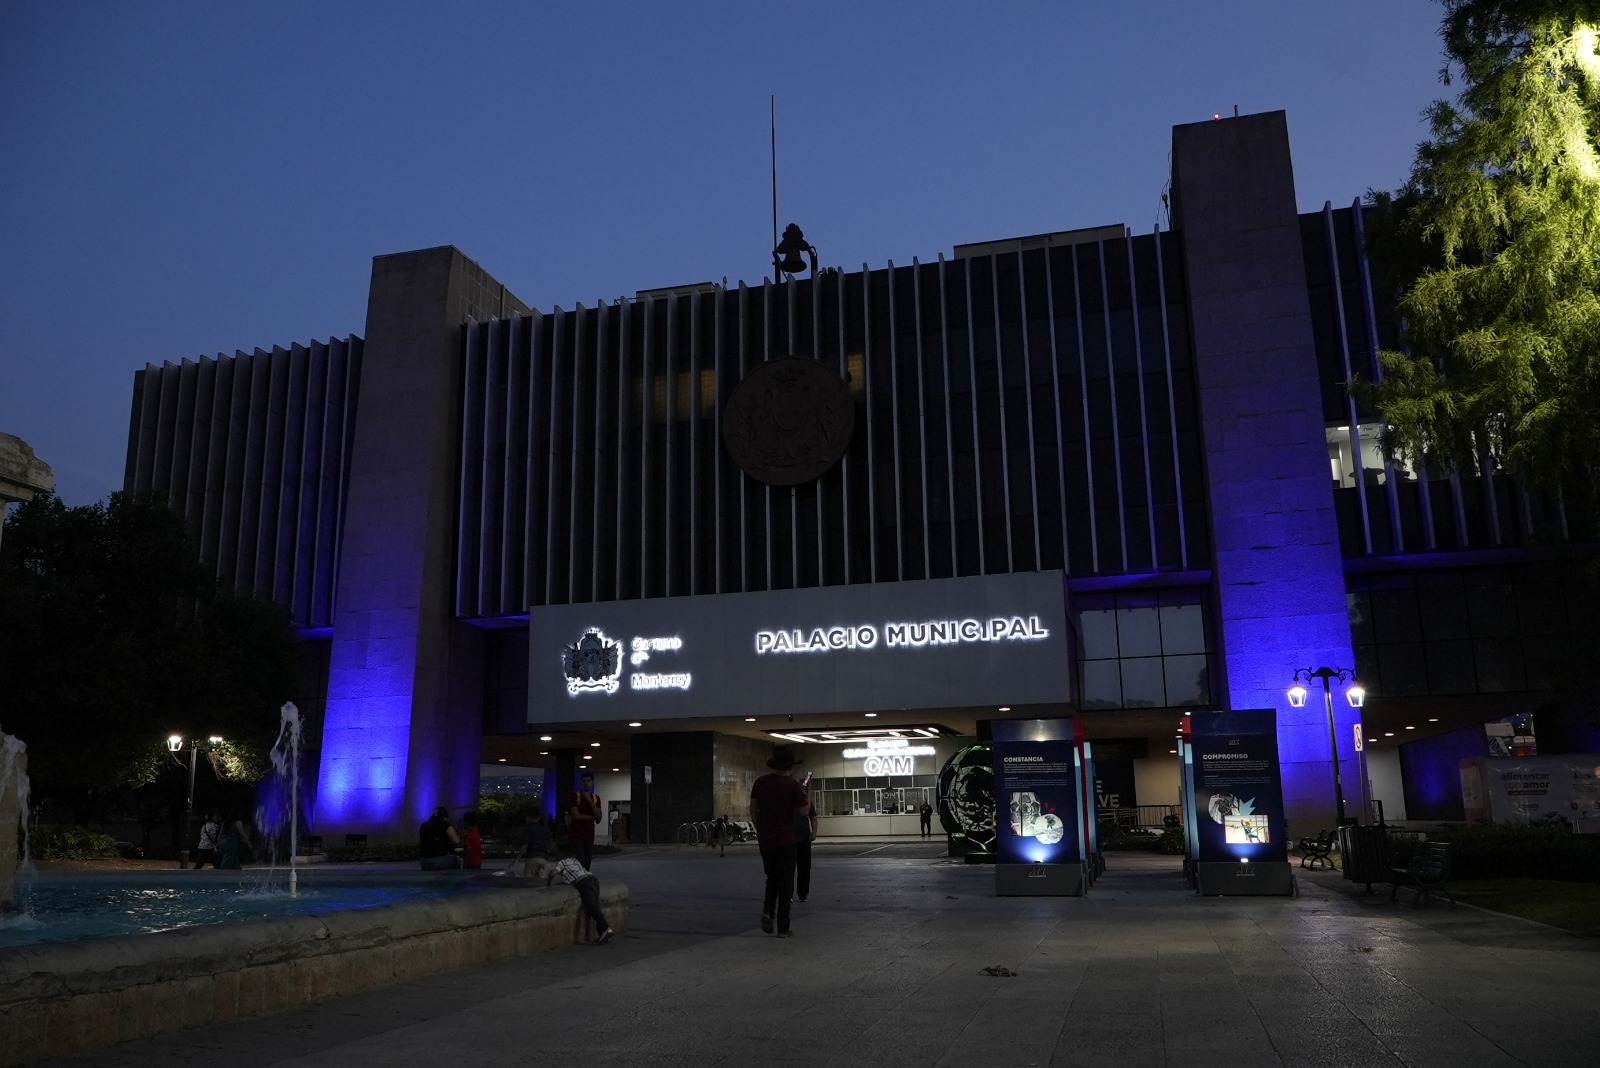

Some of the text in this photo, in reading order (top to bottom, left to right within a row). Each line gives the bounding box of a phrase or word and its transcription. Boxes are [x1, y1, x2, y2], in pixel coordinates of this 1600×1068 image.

[757, 617, 1047, 652] PALACIO MUNICIPAL
[631, 673, 691, 690] Monterrey
[865, 757, 914, 776] CAM
[1501, 772, 1550, 781] alimentar
[1523, 781, 1550, 789] amor
